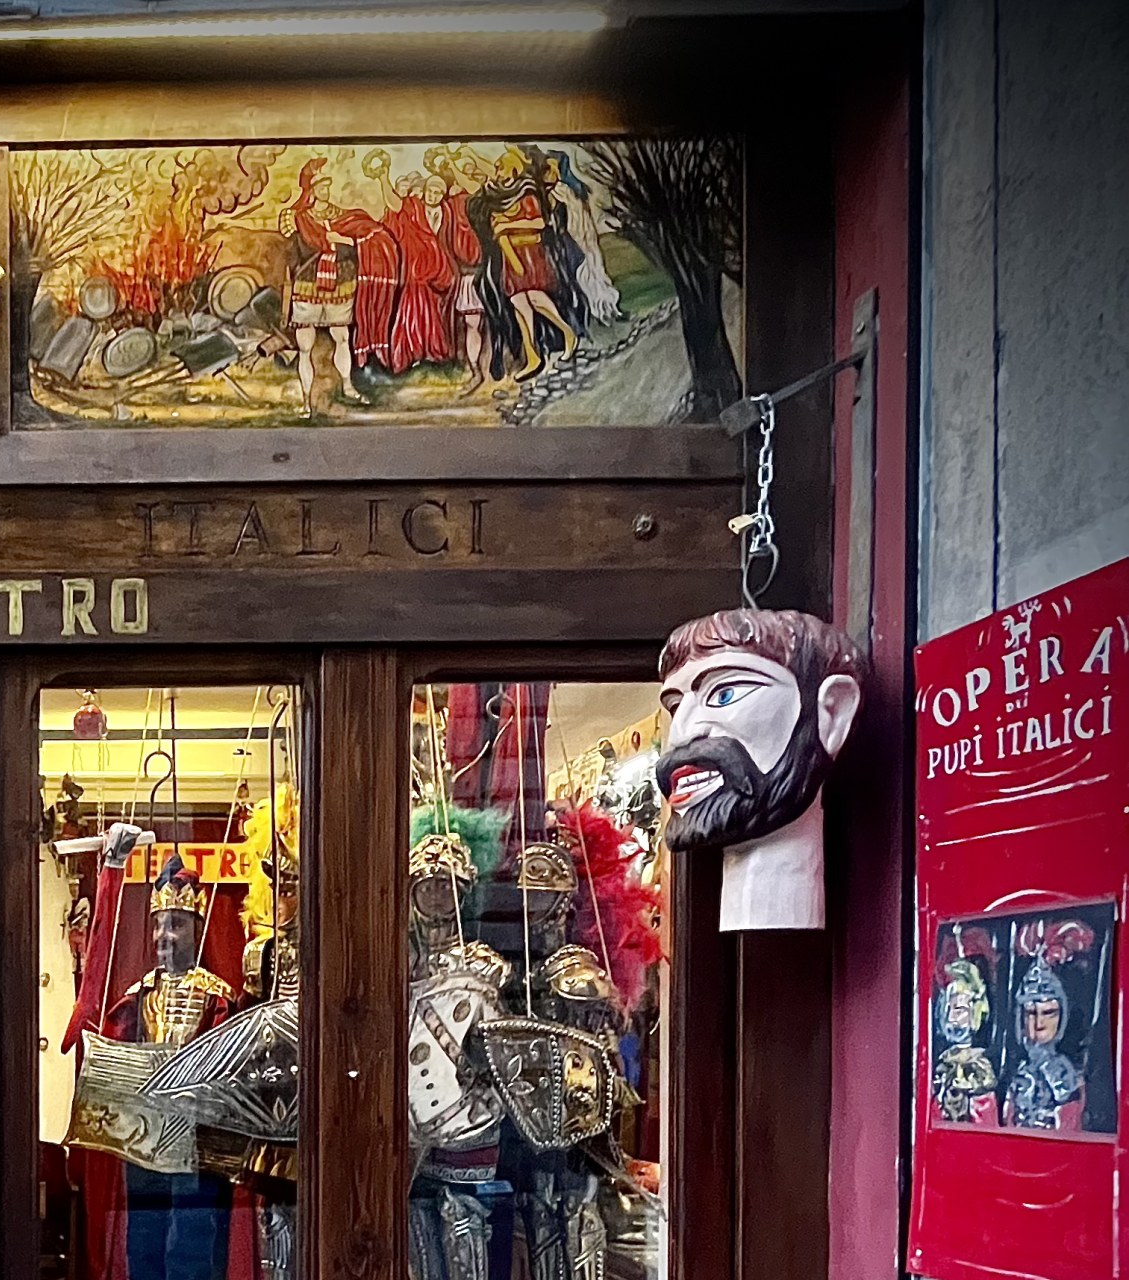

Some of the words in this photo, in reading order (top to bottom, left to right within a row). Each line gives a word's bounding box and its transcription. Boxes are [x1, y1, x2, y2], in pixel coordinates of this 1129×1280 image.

[135, 499, 490, 558] ITALICI
[932, 627, 1113, 727] OPERA
[926, 724, 984, 779] PUPI
[996, 685, 1113, 759] ITALICI
